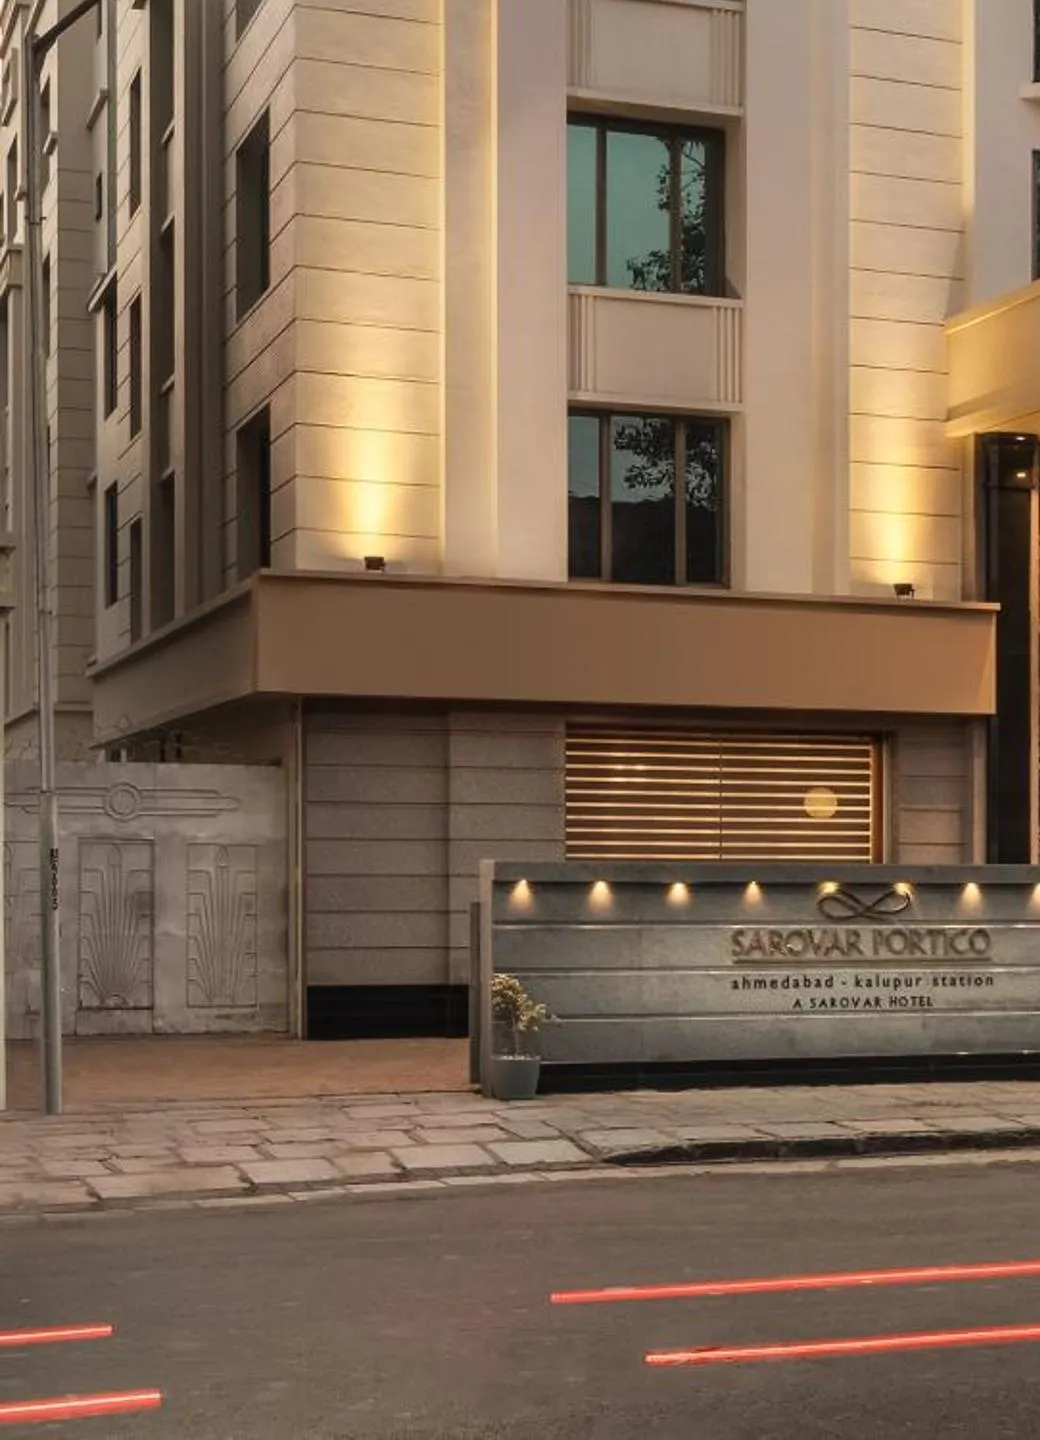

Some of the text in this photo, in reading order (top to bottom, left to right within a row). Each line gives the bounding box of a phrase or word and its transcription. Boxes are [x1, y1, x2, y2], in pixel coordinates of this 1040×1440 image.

[731, 928, 991, 957] SAROVAR PORTICO
[731, 975, 834, 990] ahmedabad
[854, 973, 922, 991] kalupur
[932, 973, 994, 987] station
[792, 995, 933, 1009] A SAROVAR HOTEL
